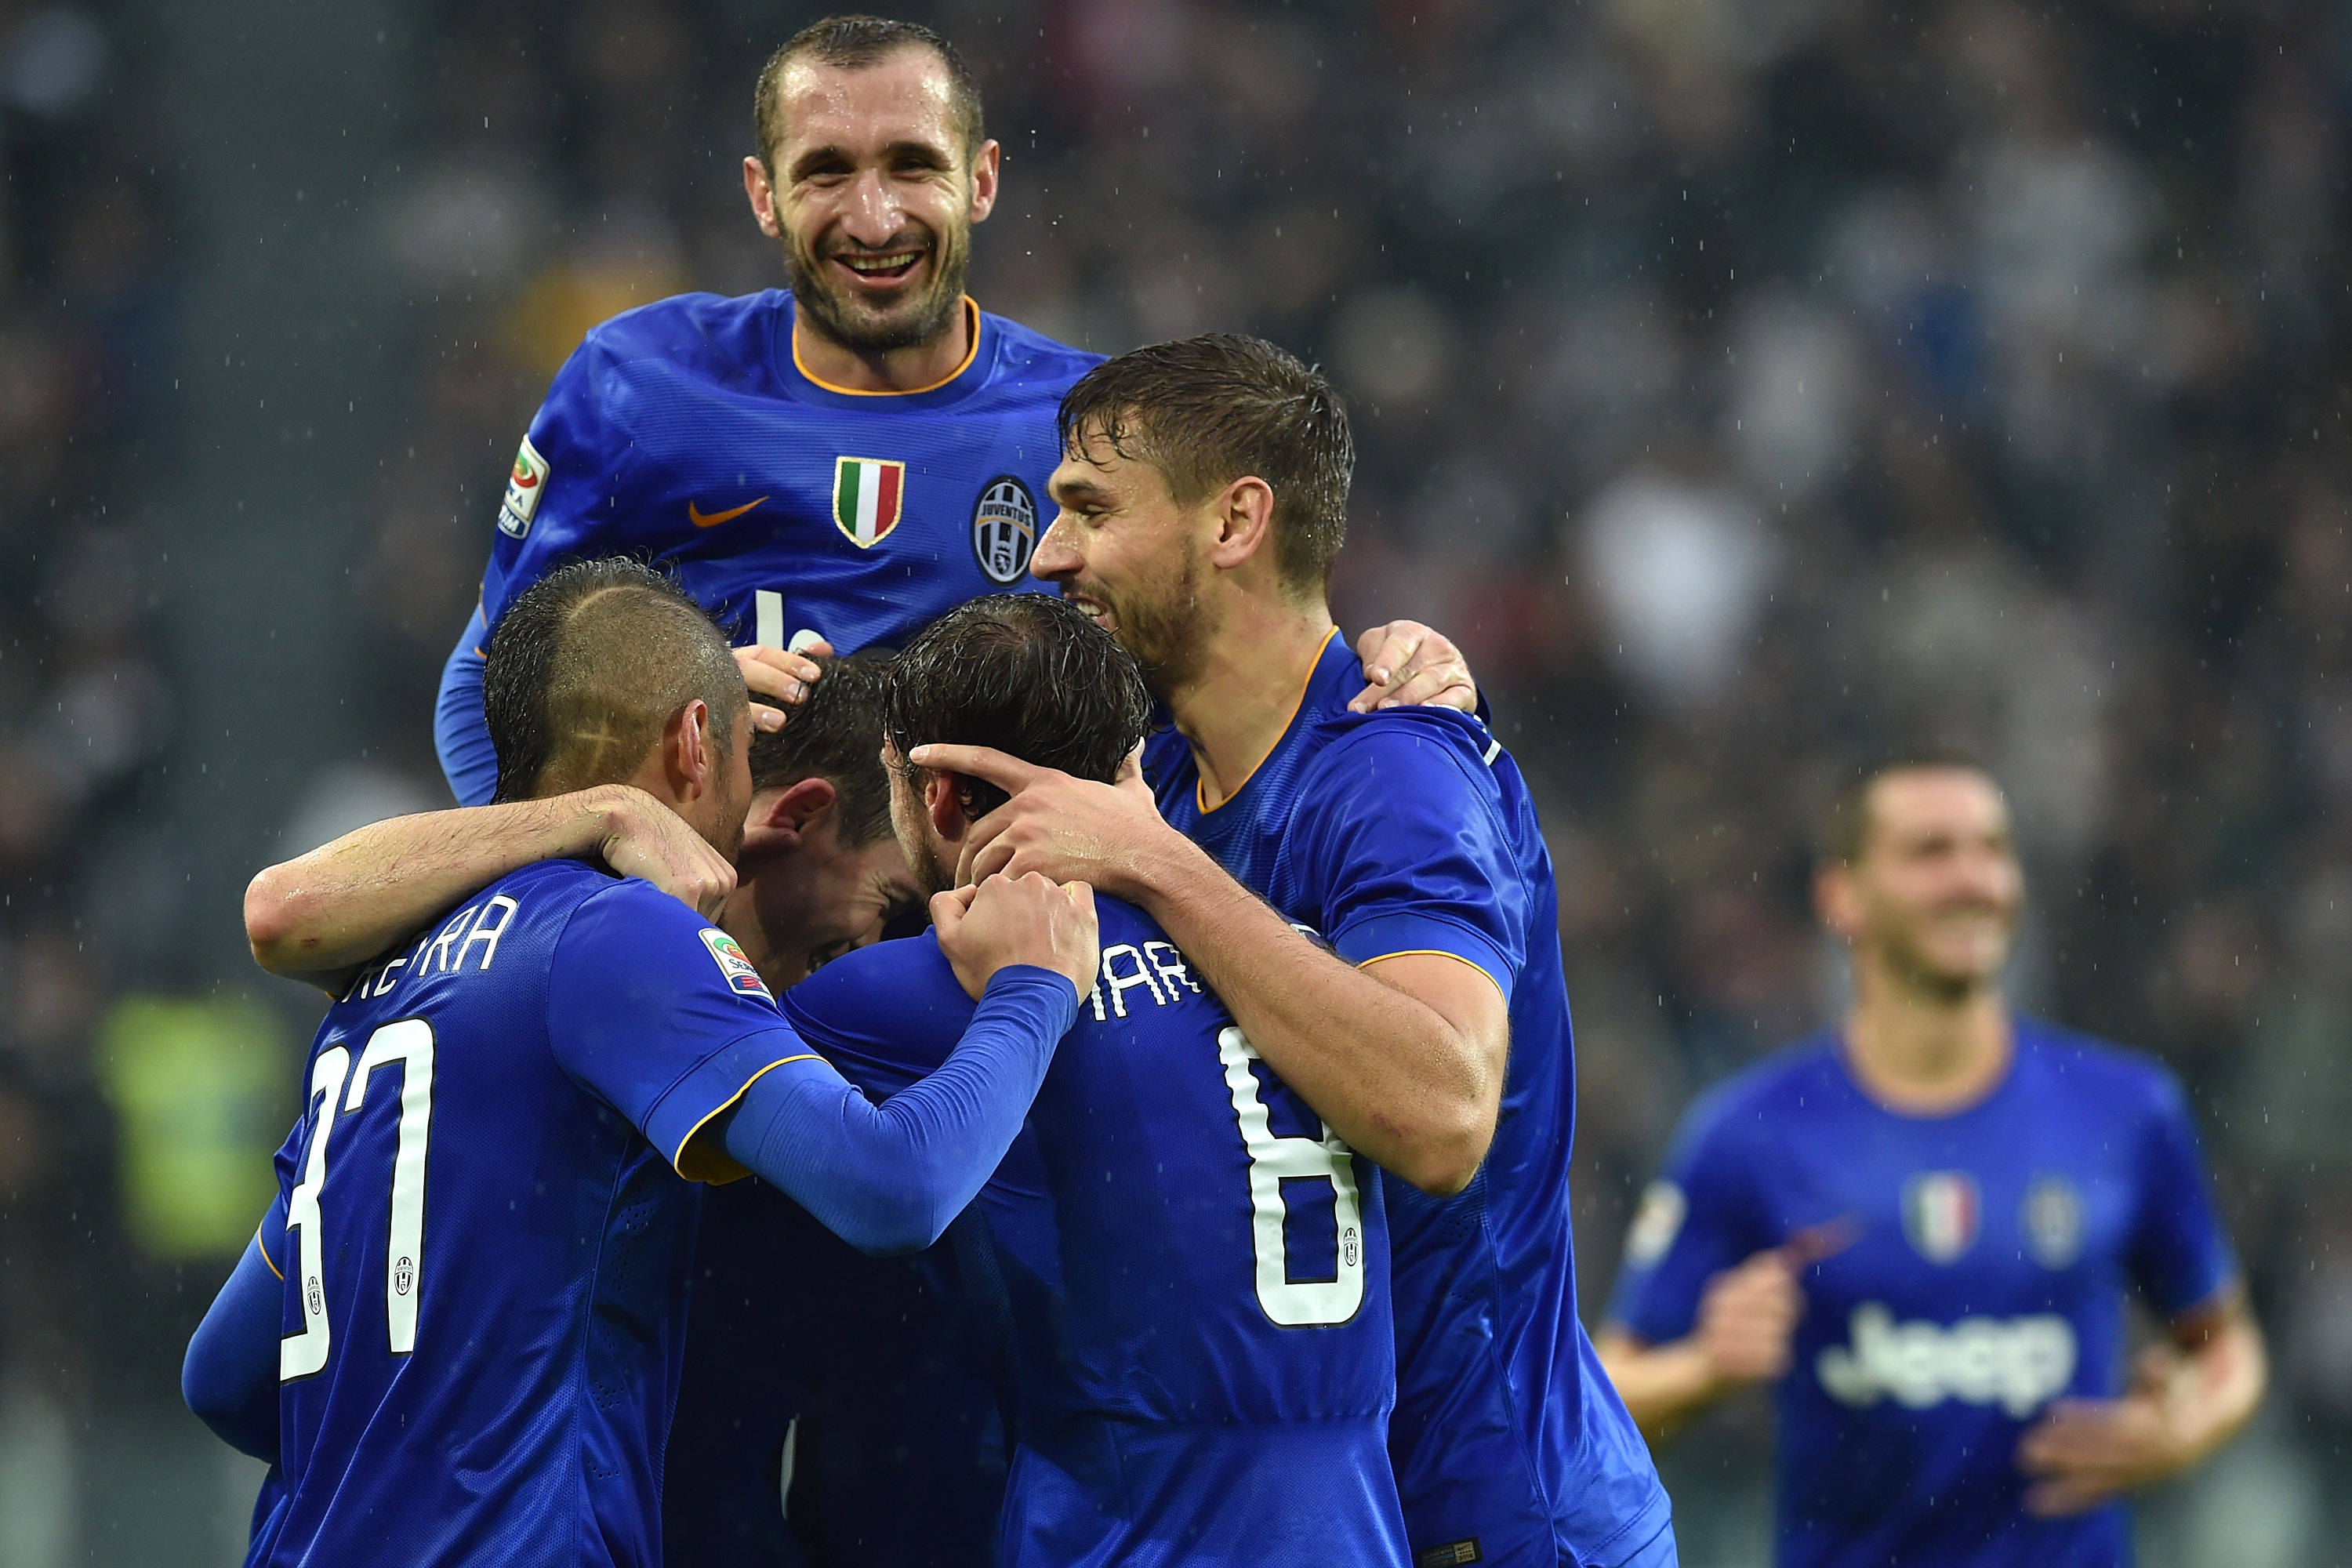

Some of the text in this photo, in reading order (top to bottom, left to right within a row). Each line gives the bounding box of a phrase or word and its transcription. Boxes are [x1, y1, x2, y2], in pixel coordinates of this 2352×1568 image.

[982, 503, 1031, 527] JUVENTUS
[279, 1018, 435, 1382] 37
[1817, 1302, 2076, 1419] Jeep
